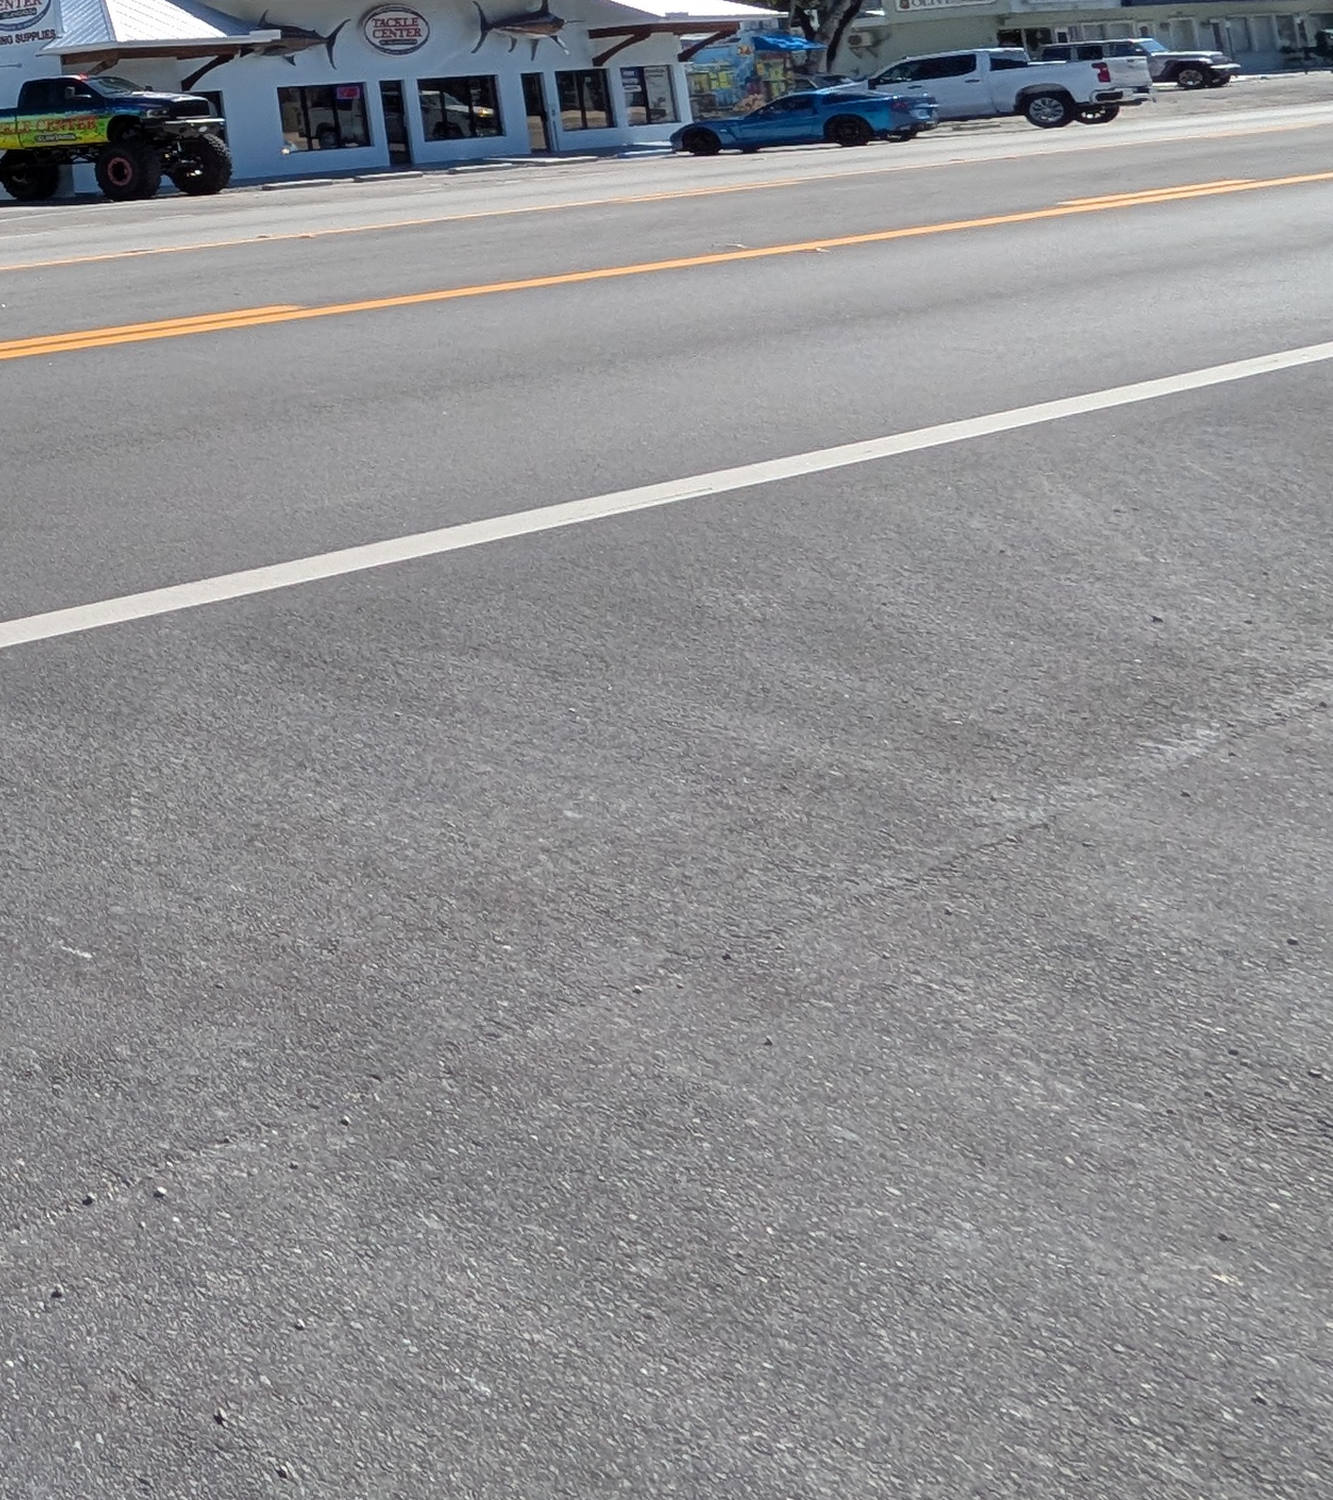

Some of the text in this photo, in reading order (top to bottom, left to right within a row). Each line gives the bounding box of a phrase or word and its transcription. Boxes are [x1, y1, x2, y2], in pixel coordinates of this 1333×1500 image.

[372, 17, 419, 28] TACKLE
[15, 29, 57, 44] SUPPLIES
[373, 28, 422, 39] CENTER
[35, 116, 98, 132] CENTER
